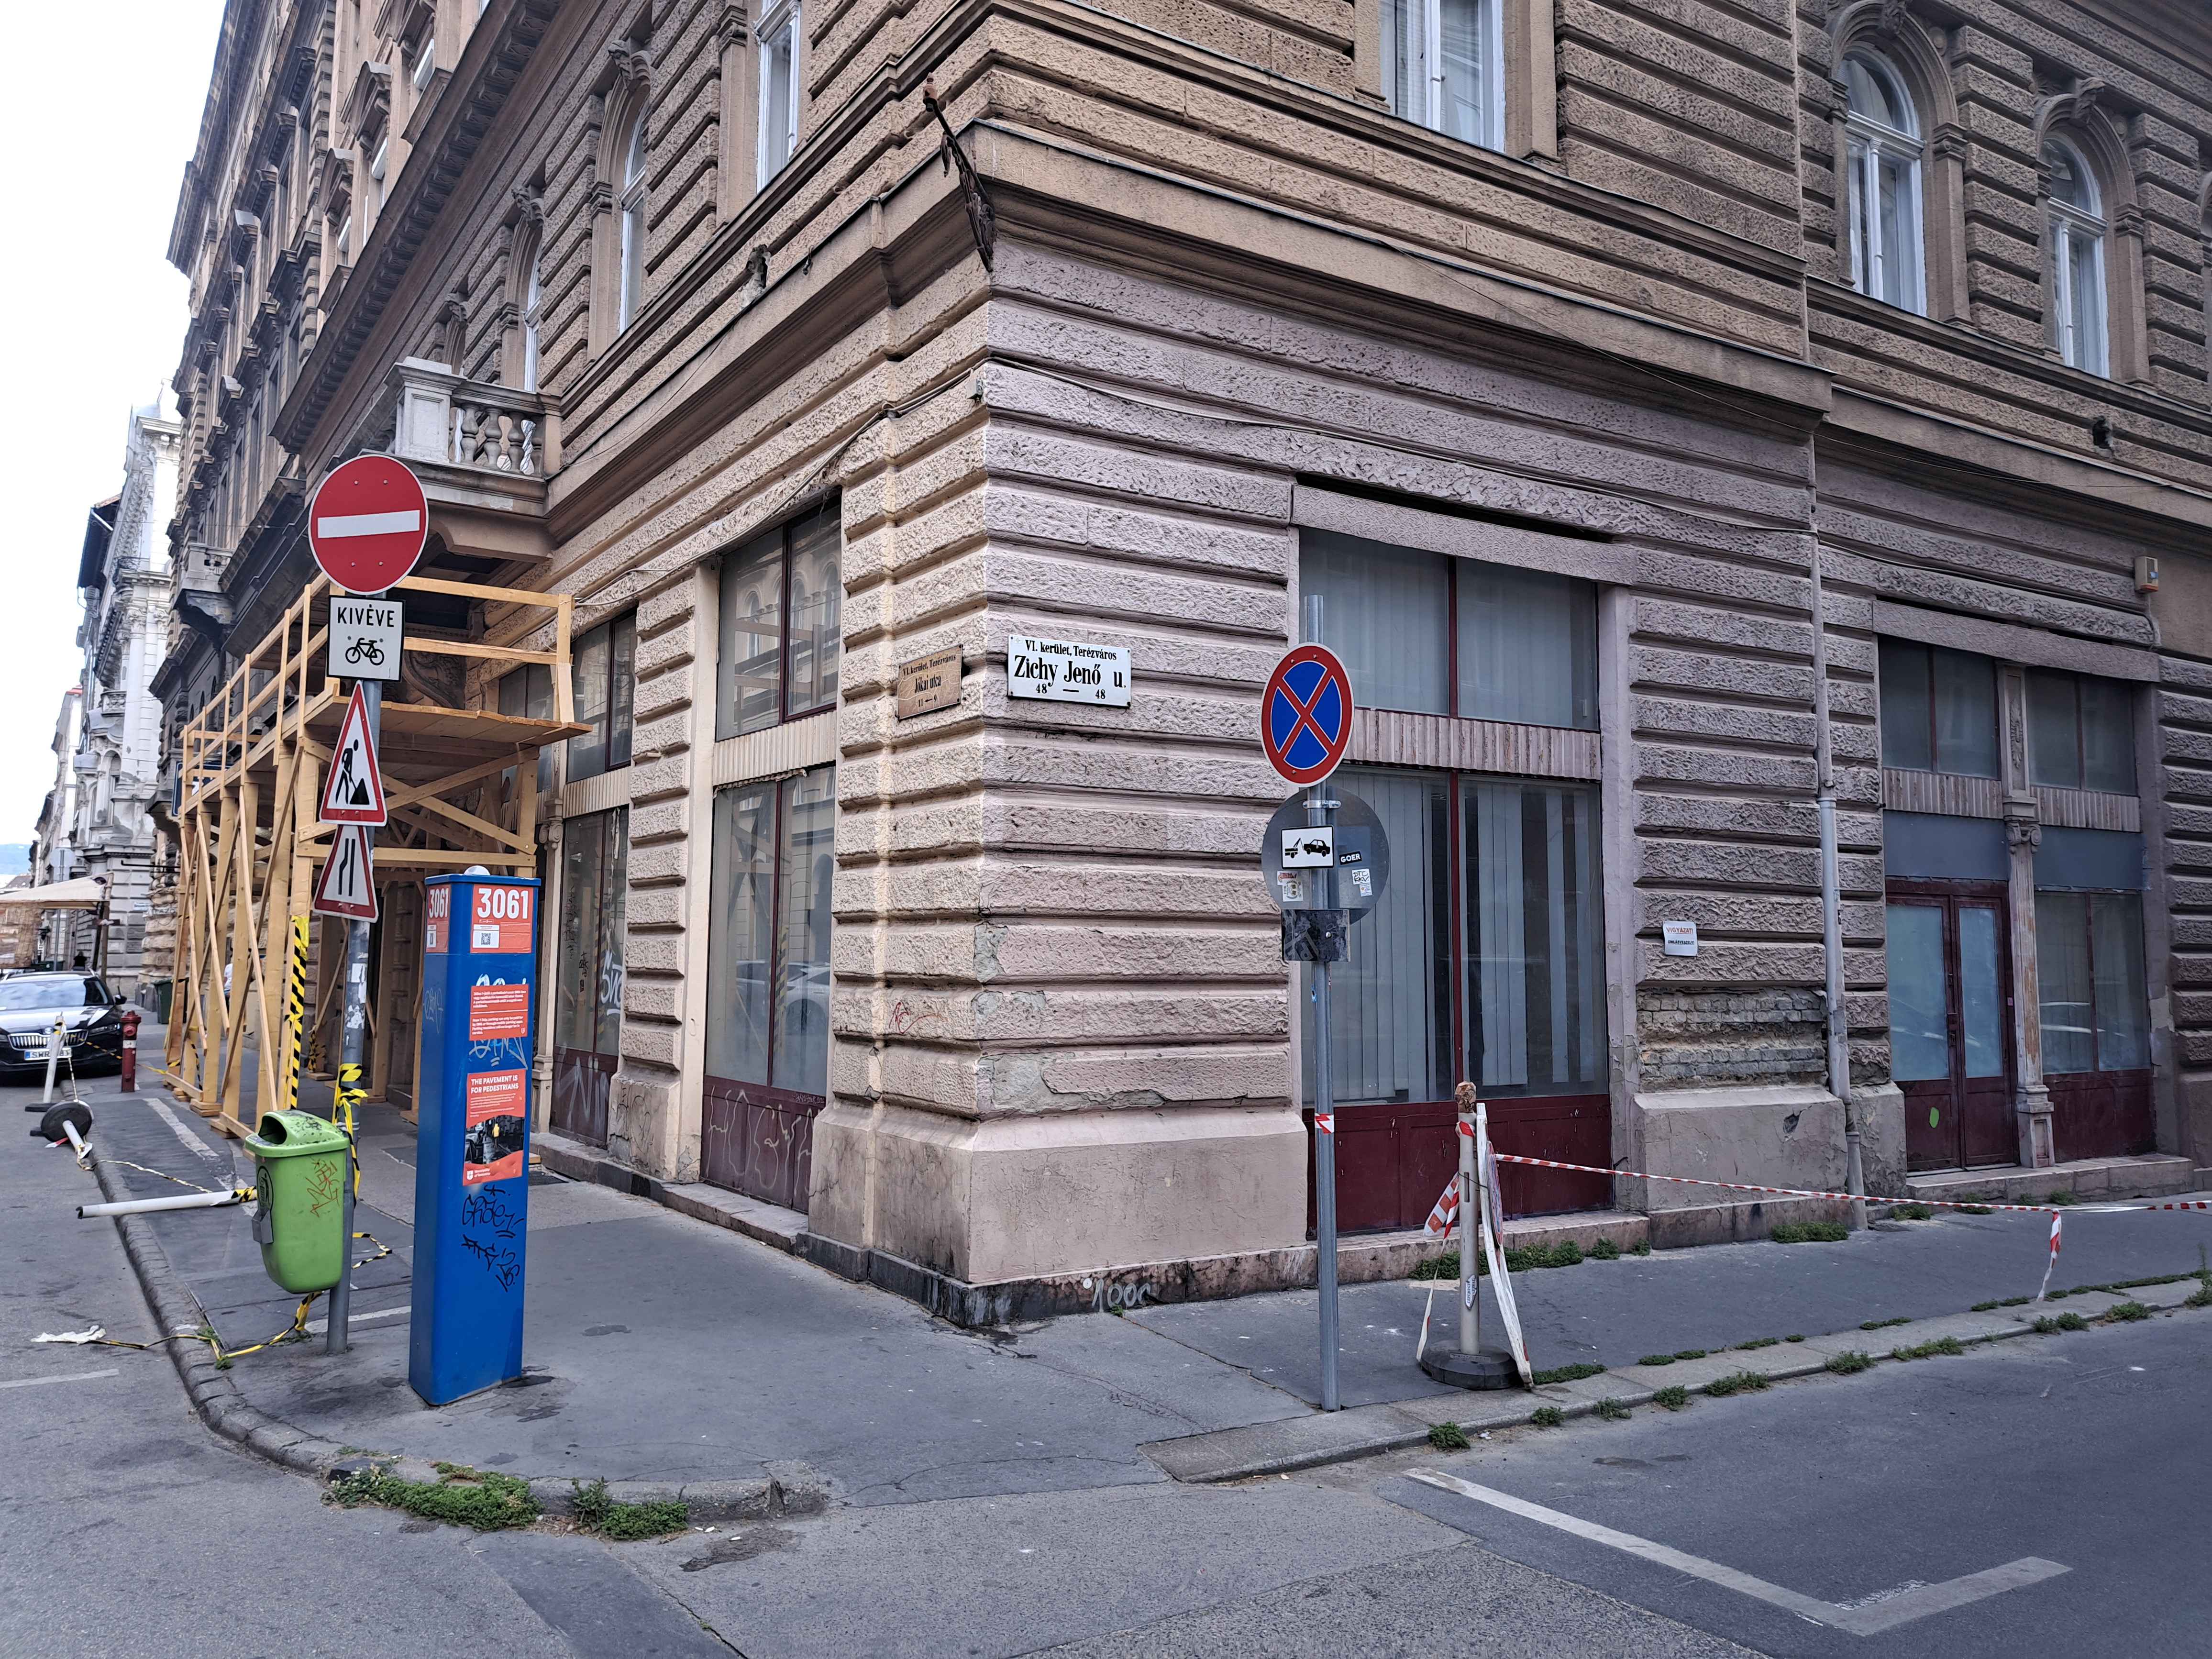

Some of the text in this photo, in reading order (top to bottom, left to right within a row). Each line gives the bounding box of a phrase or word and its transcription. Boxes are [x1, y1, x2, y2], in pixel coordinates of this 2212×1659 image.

[1025, 640, 1117, 660] VI. kerület, Terézváros
[911, 663, 929, 674] kerület,
[929, 654, 956, 668] Terézváros
[1014, 655, 1126, 688] Zichy Jenő u.
[915, 675, 941, 693] Jókai utca
[1036, 683, 1047, 694] 48
[1095, 689, 1106, 699] 48
[918, 694, 937, 707] 11 9
[1340, 853, 1361, 863] GOER
[429, 888, 449, 918] 3061
[477, 888, 528, 919] 3061
[483, 1075, 512, 1084] PAVEMENT
[483, 1083, 519, 1093] PEDESTRIANS
